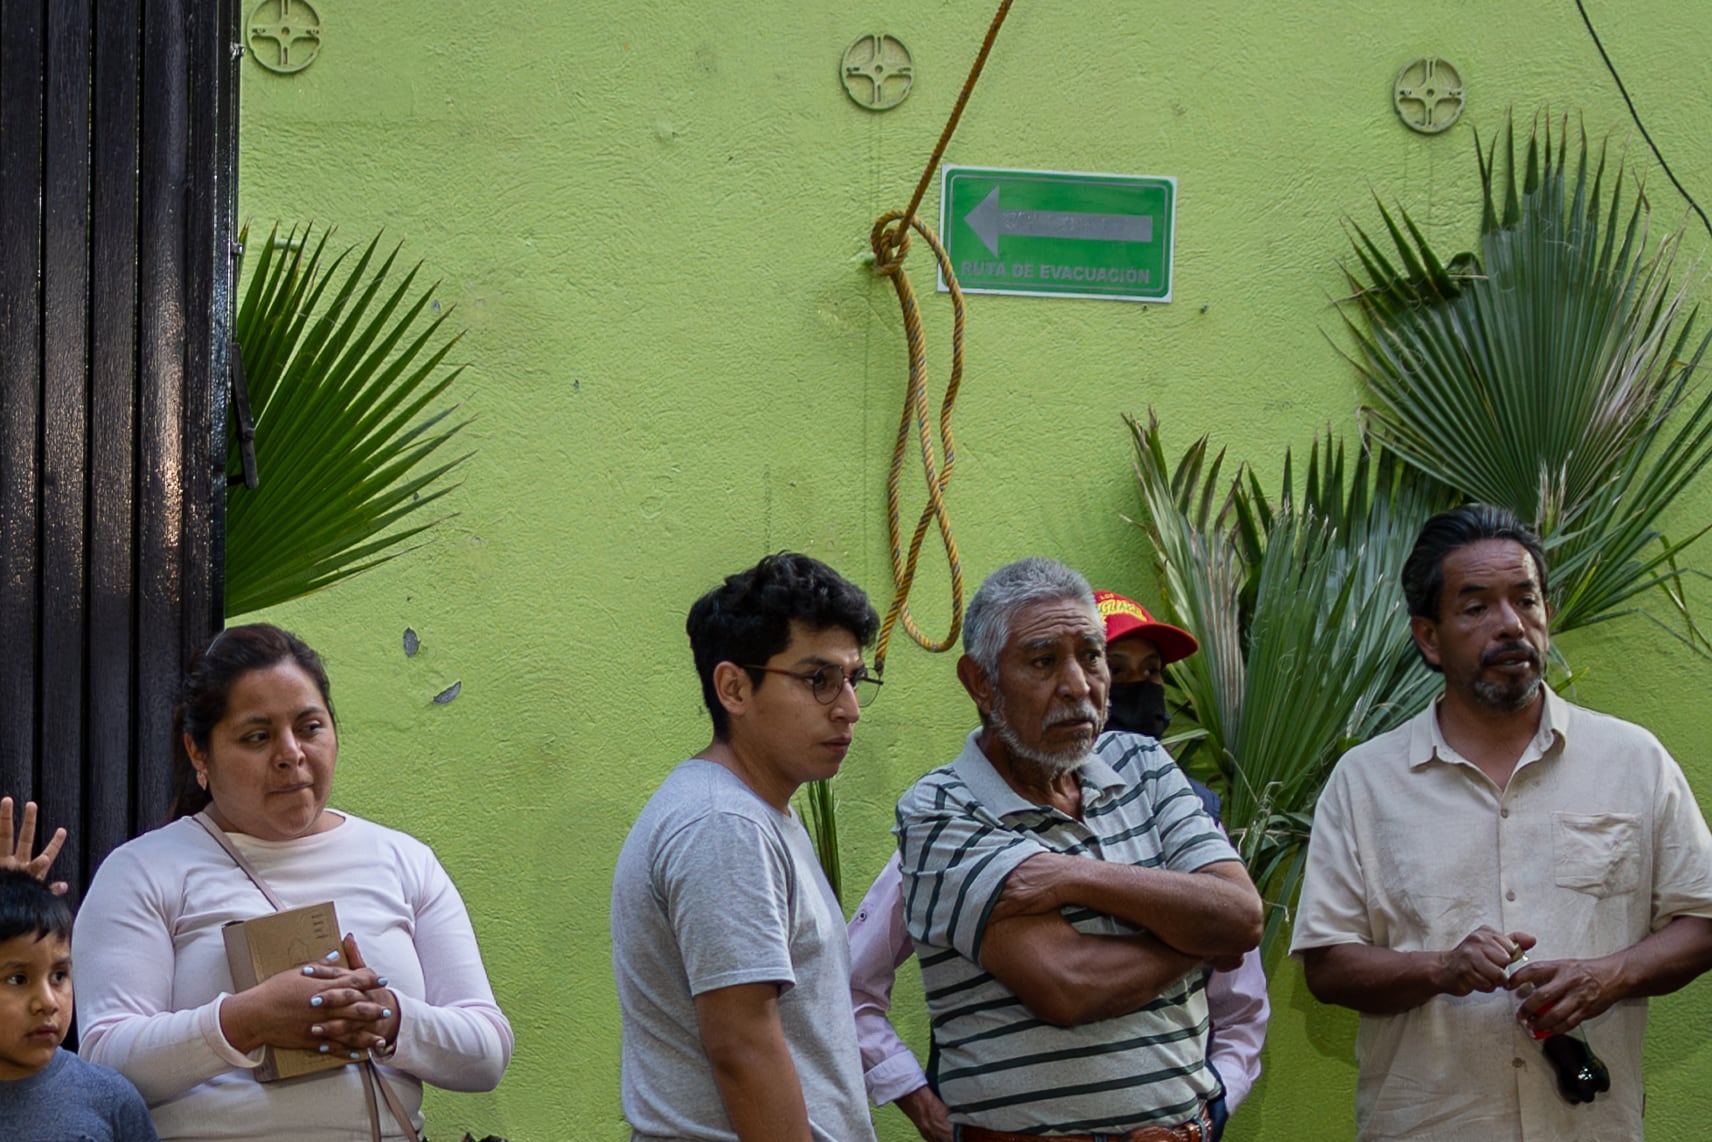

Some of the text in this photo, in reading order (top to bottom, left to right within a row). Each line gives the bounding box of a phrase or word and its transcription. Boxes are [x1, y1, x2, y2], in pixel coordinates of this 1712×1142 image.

[961, 261, 1150, 284] RUTA DE EVACUACIÓN
